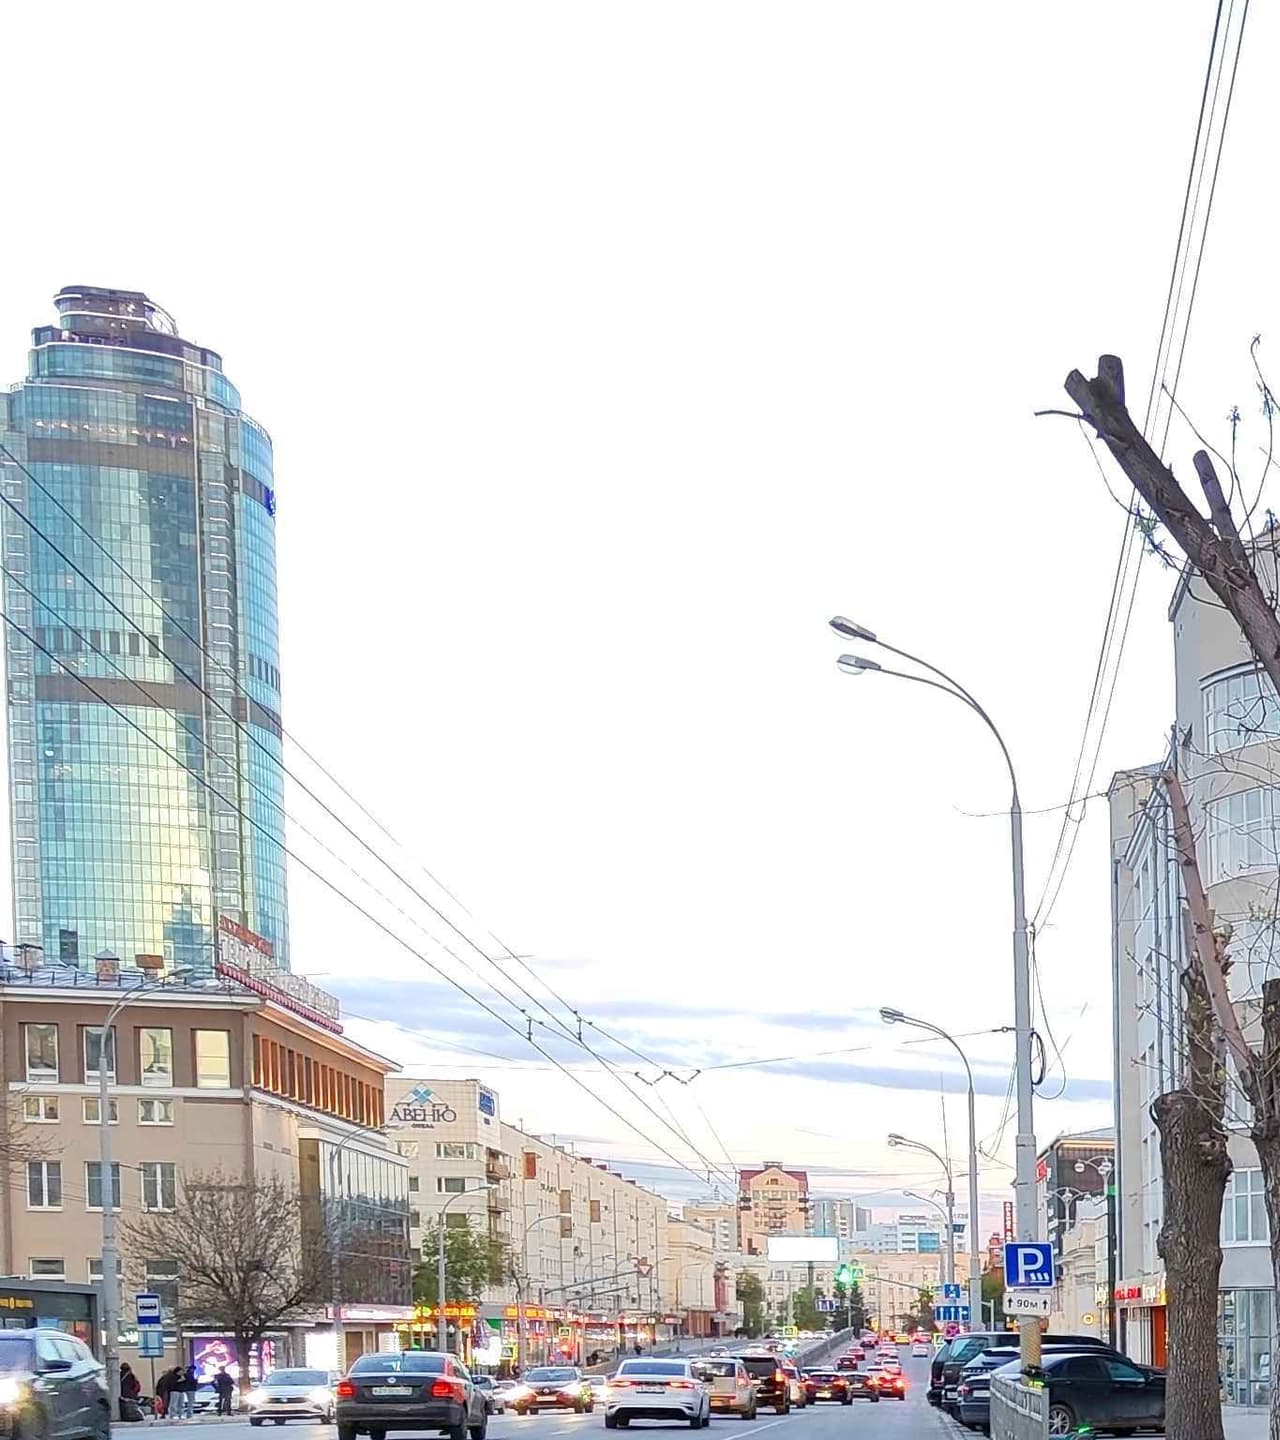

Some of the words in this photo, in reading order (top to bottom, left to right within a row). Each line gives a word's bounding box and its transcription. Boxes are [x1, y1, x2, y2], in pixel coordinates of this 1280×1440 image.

[389, 1107, 457, 1123] АВЕНЮ
[1017, 1248, 1044, 1283] P
[1016, 1298, 1038, 1309] 90м
